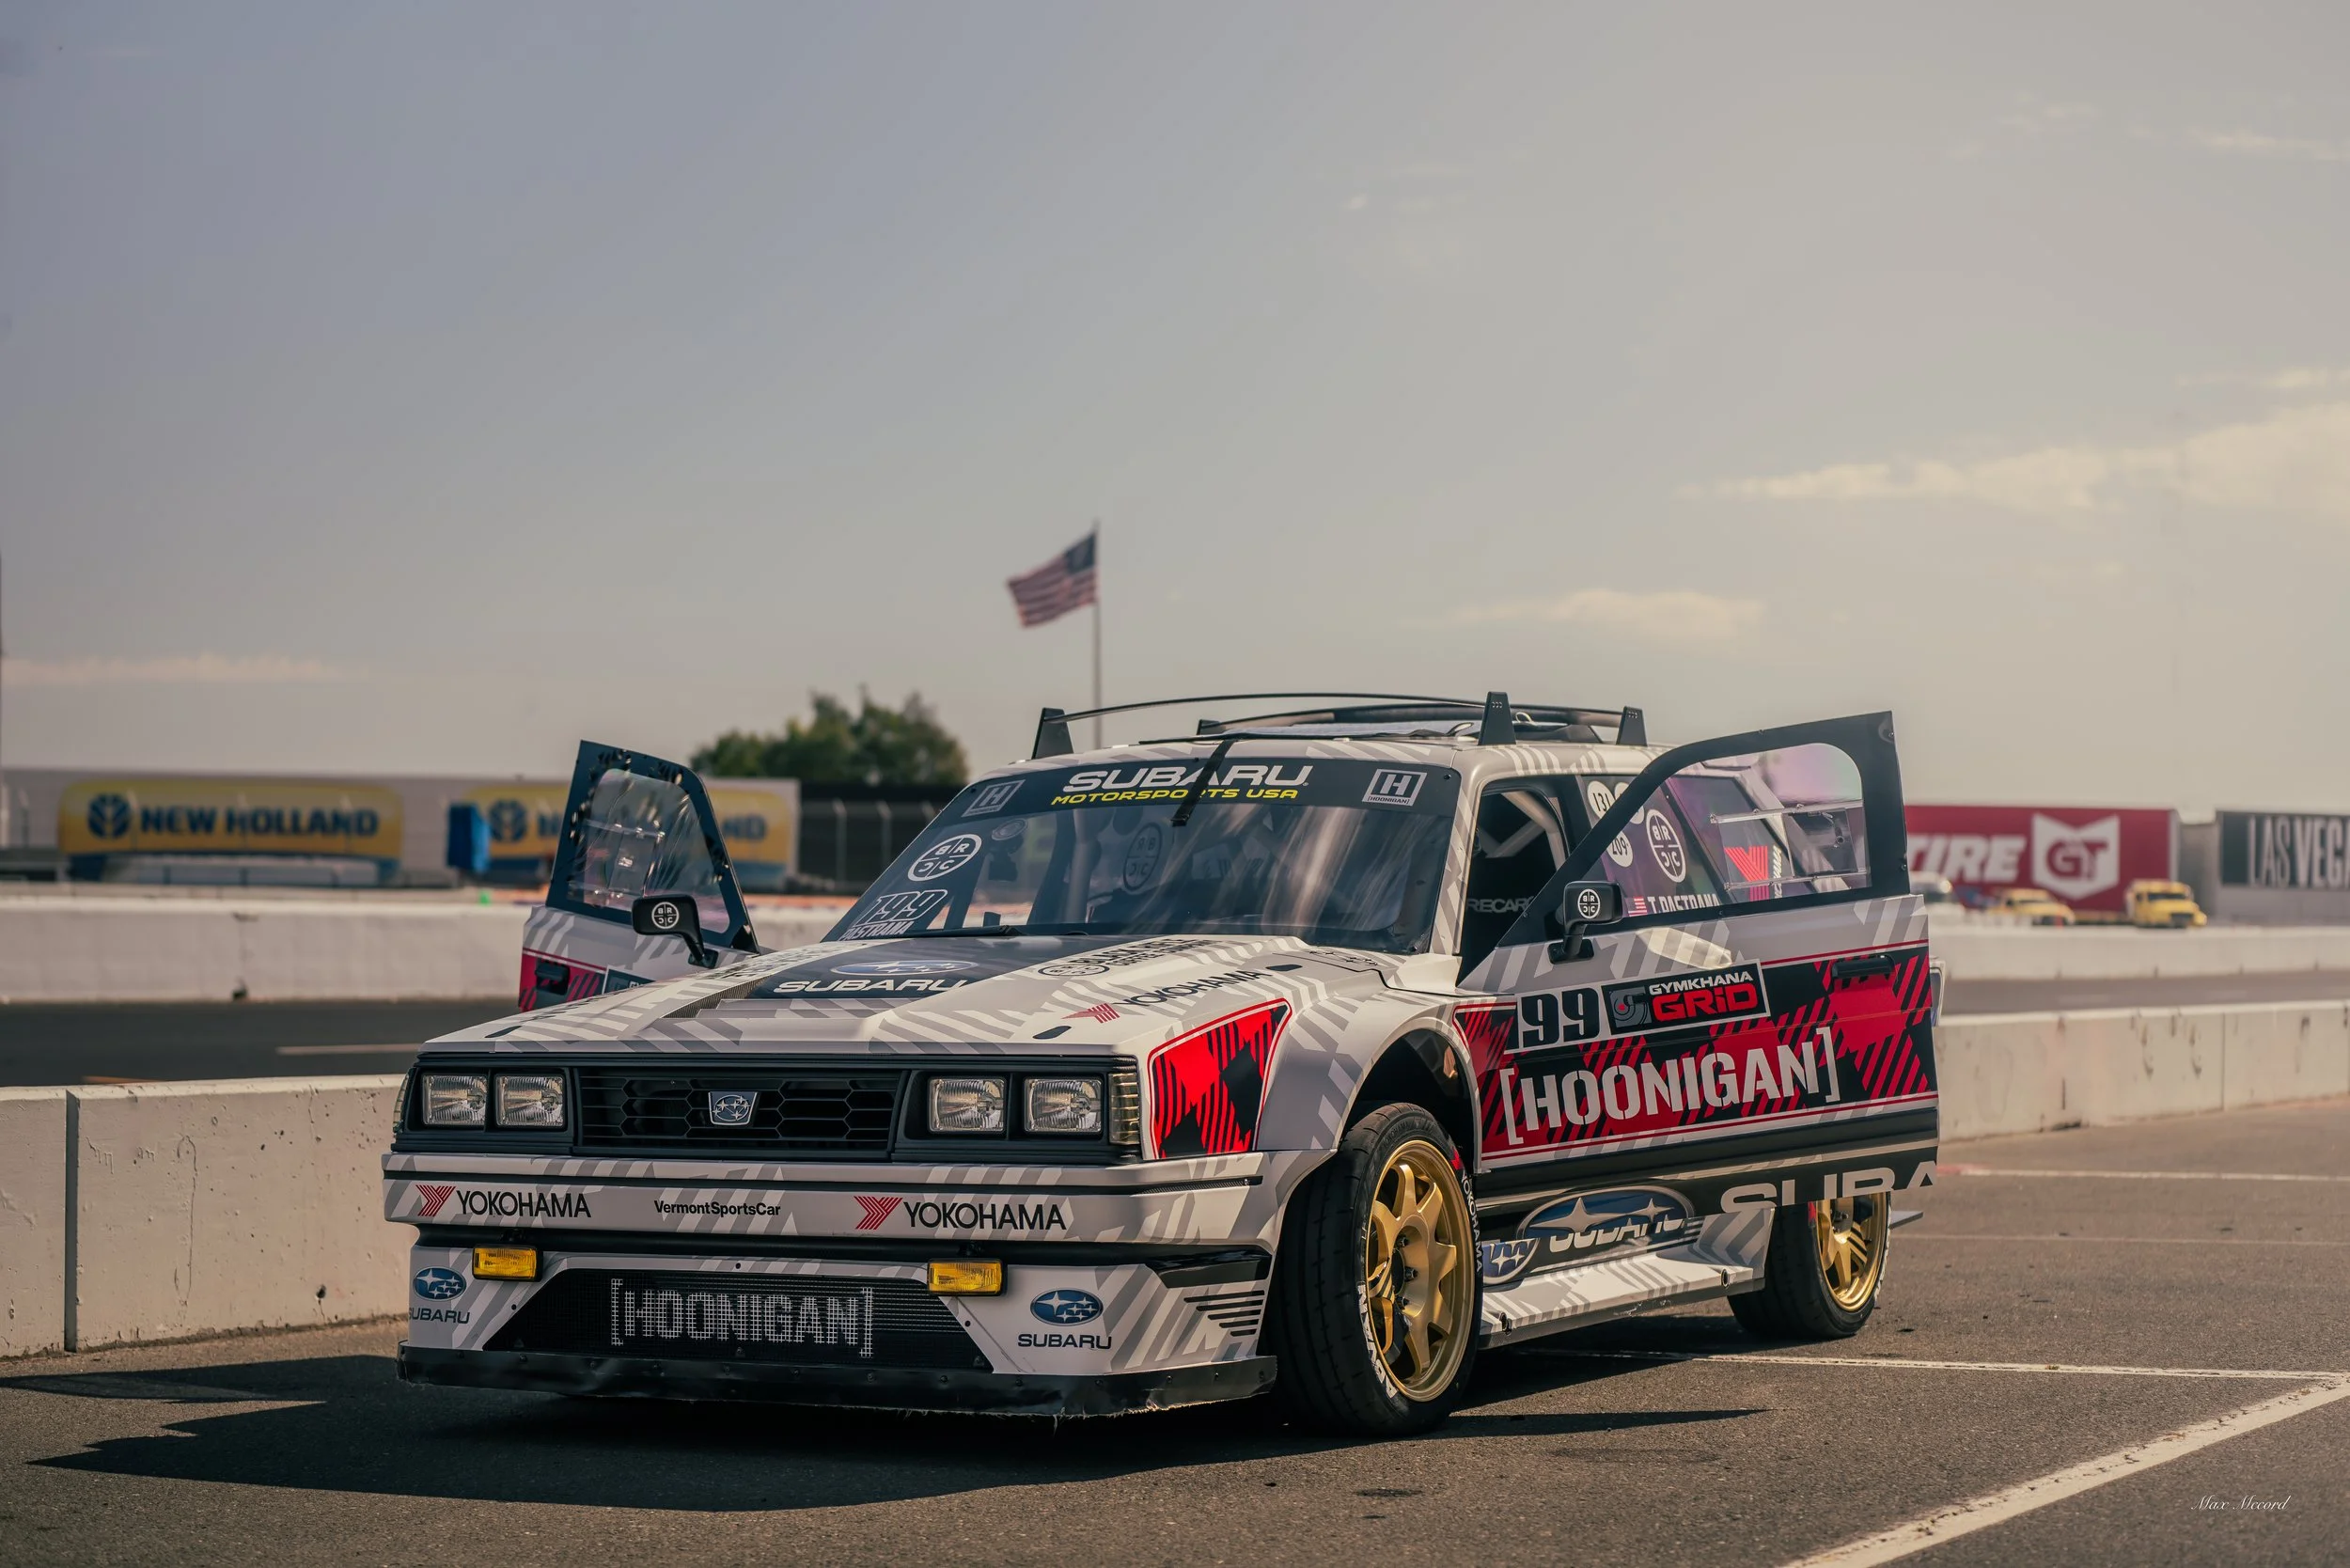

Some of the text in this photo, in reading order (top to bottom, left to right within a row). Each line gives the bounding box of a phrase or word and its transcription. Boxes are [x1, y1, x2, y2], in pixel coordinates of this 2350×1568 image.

[1063, 765, 1314, 792] SUBARU
[1051, 789, 1298, 806] MOTORSPOTS USA
[140, 807, 380, 836] NEW HOLLAND
[1907, 835, 2027, 883] TIRE
[2248, 814, 2291, 888] LAS
[852, 889, 948, 927] 199
[838, 920, 916, 941] PASTRANA
[774, 979, 967, 993] SUBARU
[1113, 970, 1273, 1007] YOKOHAMA
[1649, 970, 1754, 996] GYMKHANA
[456, 1190, 591, 1218] YOKOHAMA
[654, 1200, 781, 1216] VermontSportsCar
[903, 1201, 1066, 1231] YOKOHAMA
[1461, 1168, 1482, 1273] YOKOHAMA
[1017, 1333, 1113, 1350] SUBARU
